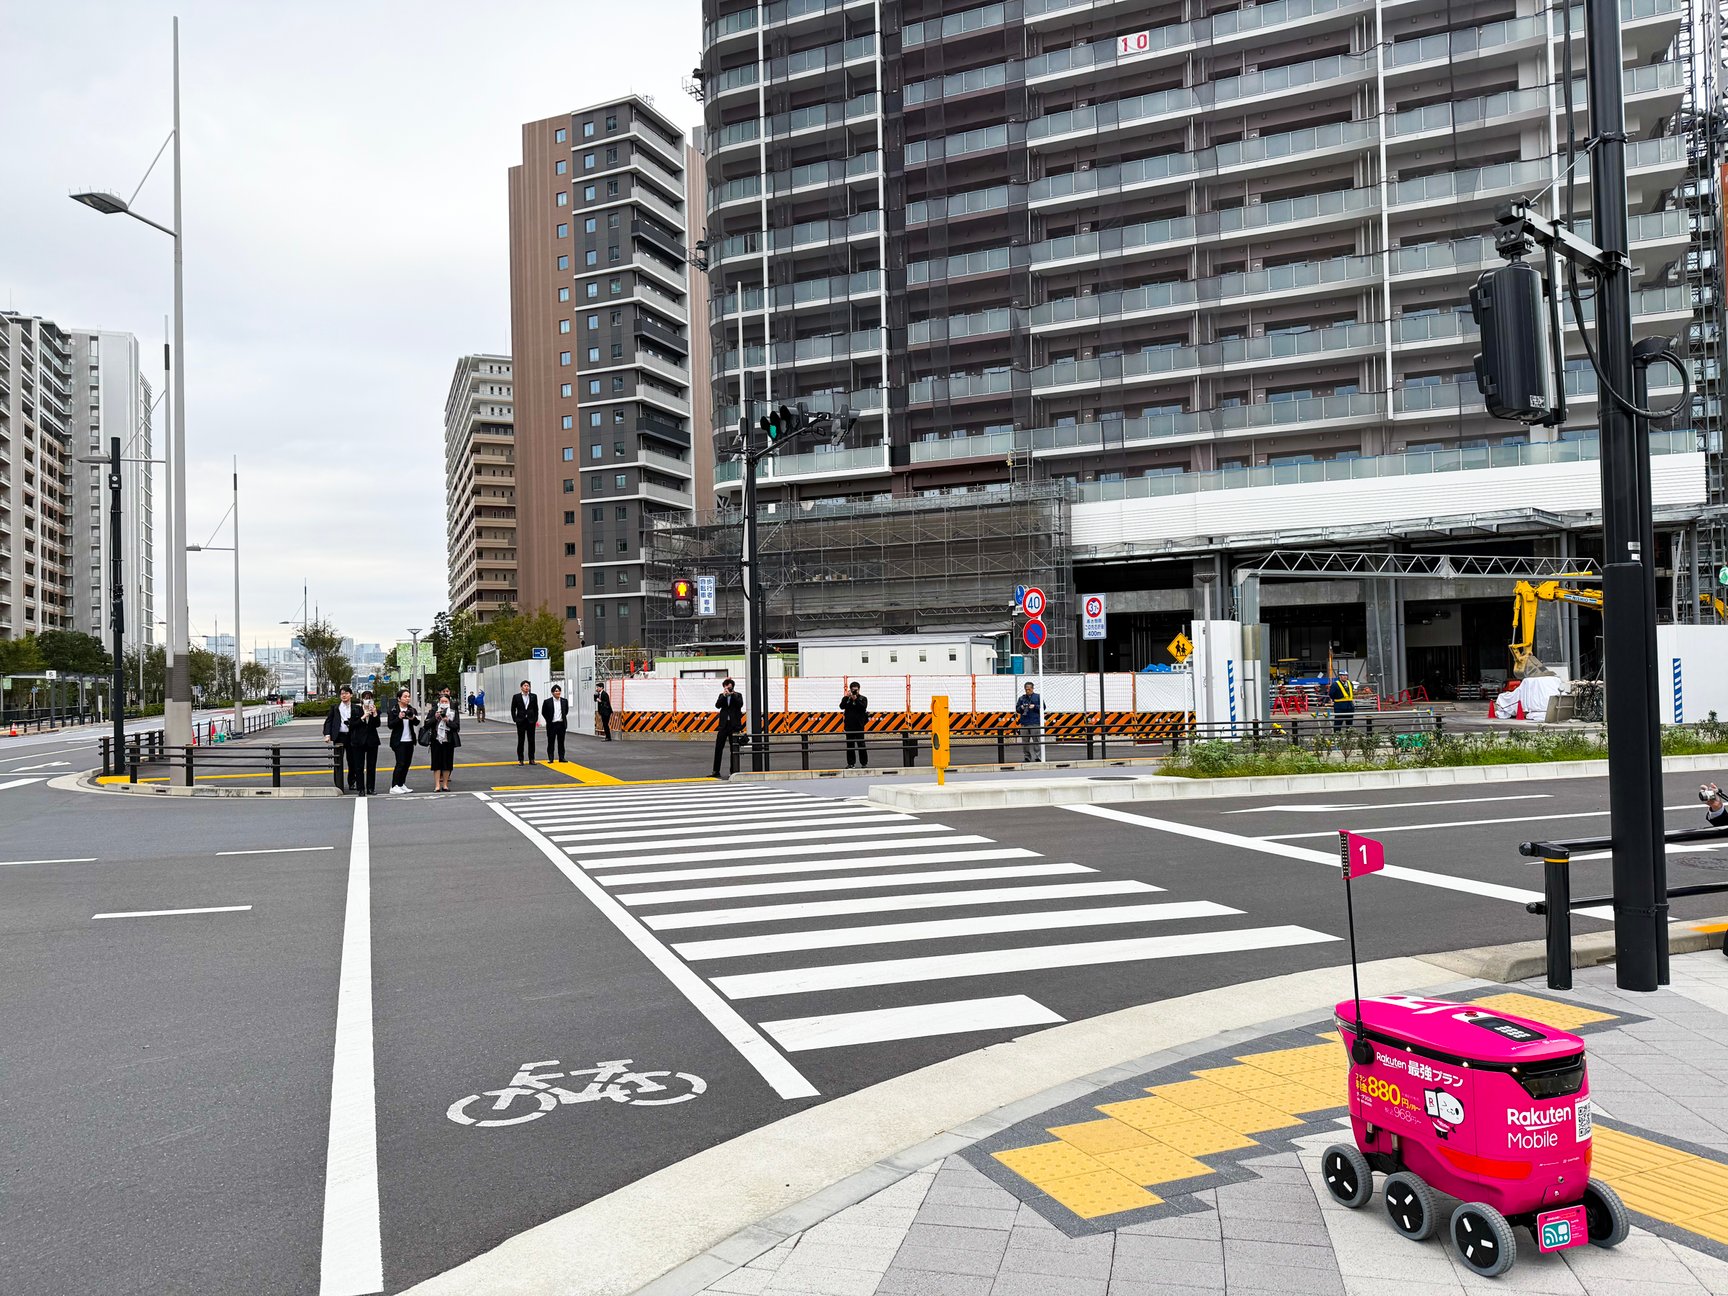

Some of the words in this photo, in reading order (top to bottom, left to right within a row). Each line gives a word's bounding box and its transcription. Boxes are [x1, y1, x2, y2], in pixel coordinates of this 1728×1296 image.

[1028, 596, 1040, 609] 40
[1359, 845, 1367, 865] 1
[1376, 1052, 1407, 1070] Rakuten
[1408, 1060, 1464, 1087] 最強プラン
[1507, 1106, 1572, 1127] Rakuten
[1507, 1131, 1559, 1150] Mobile
